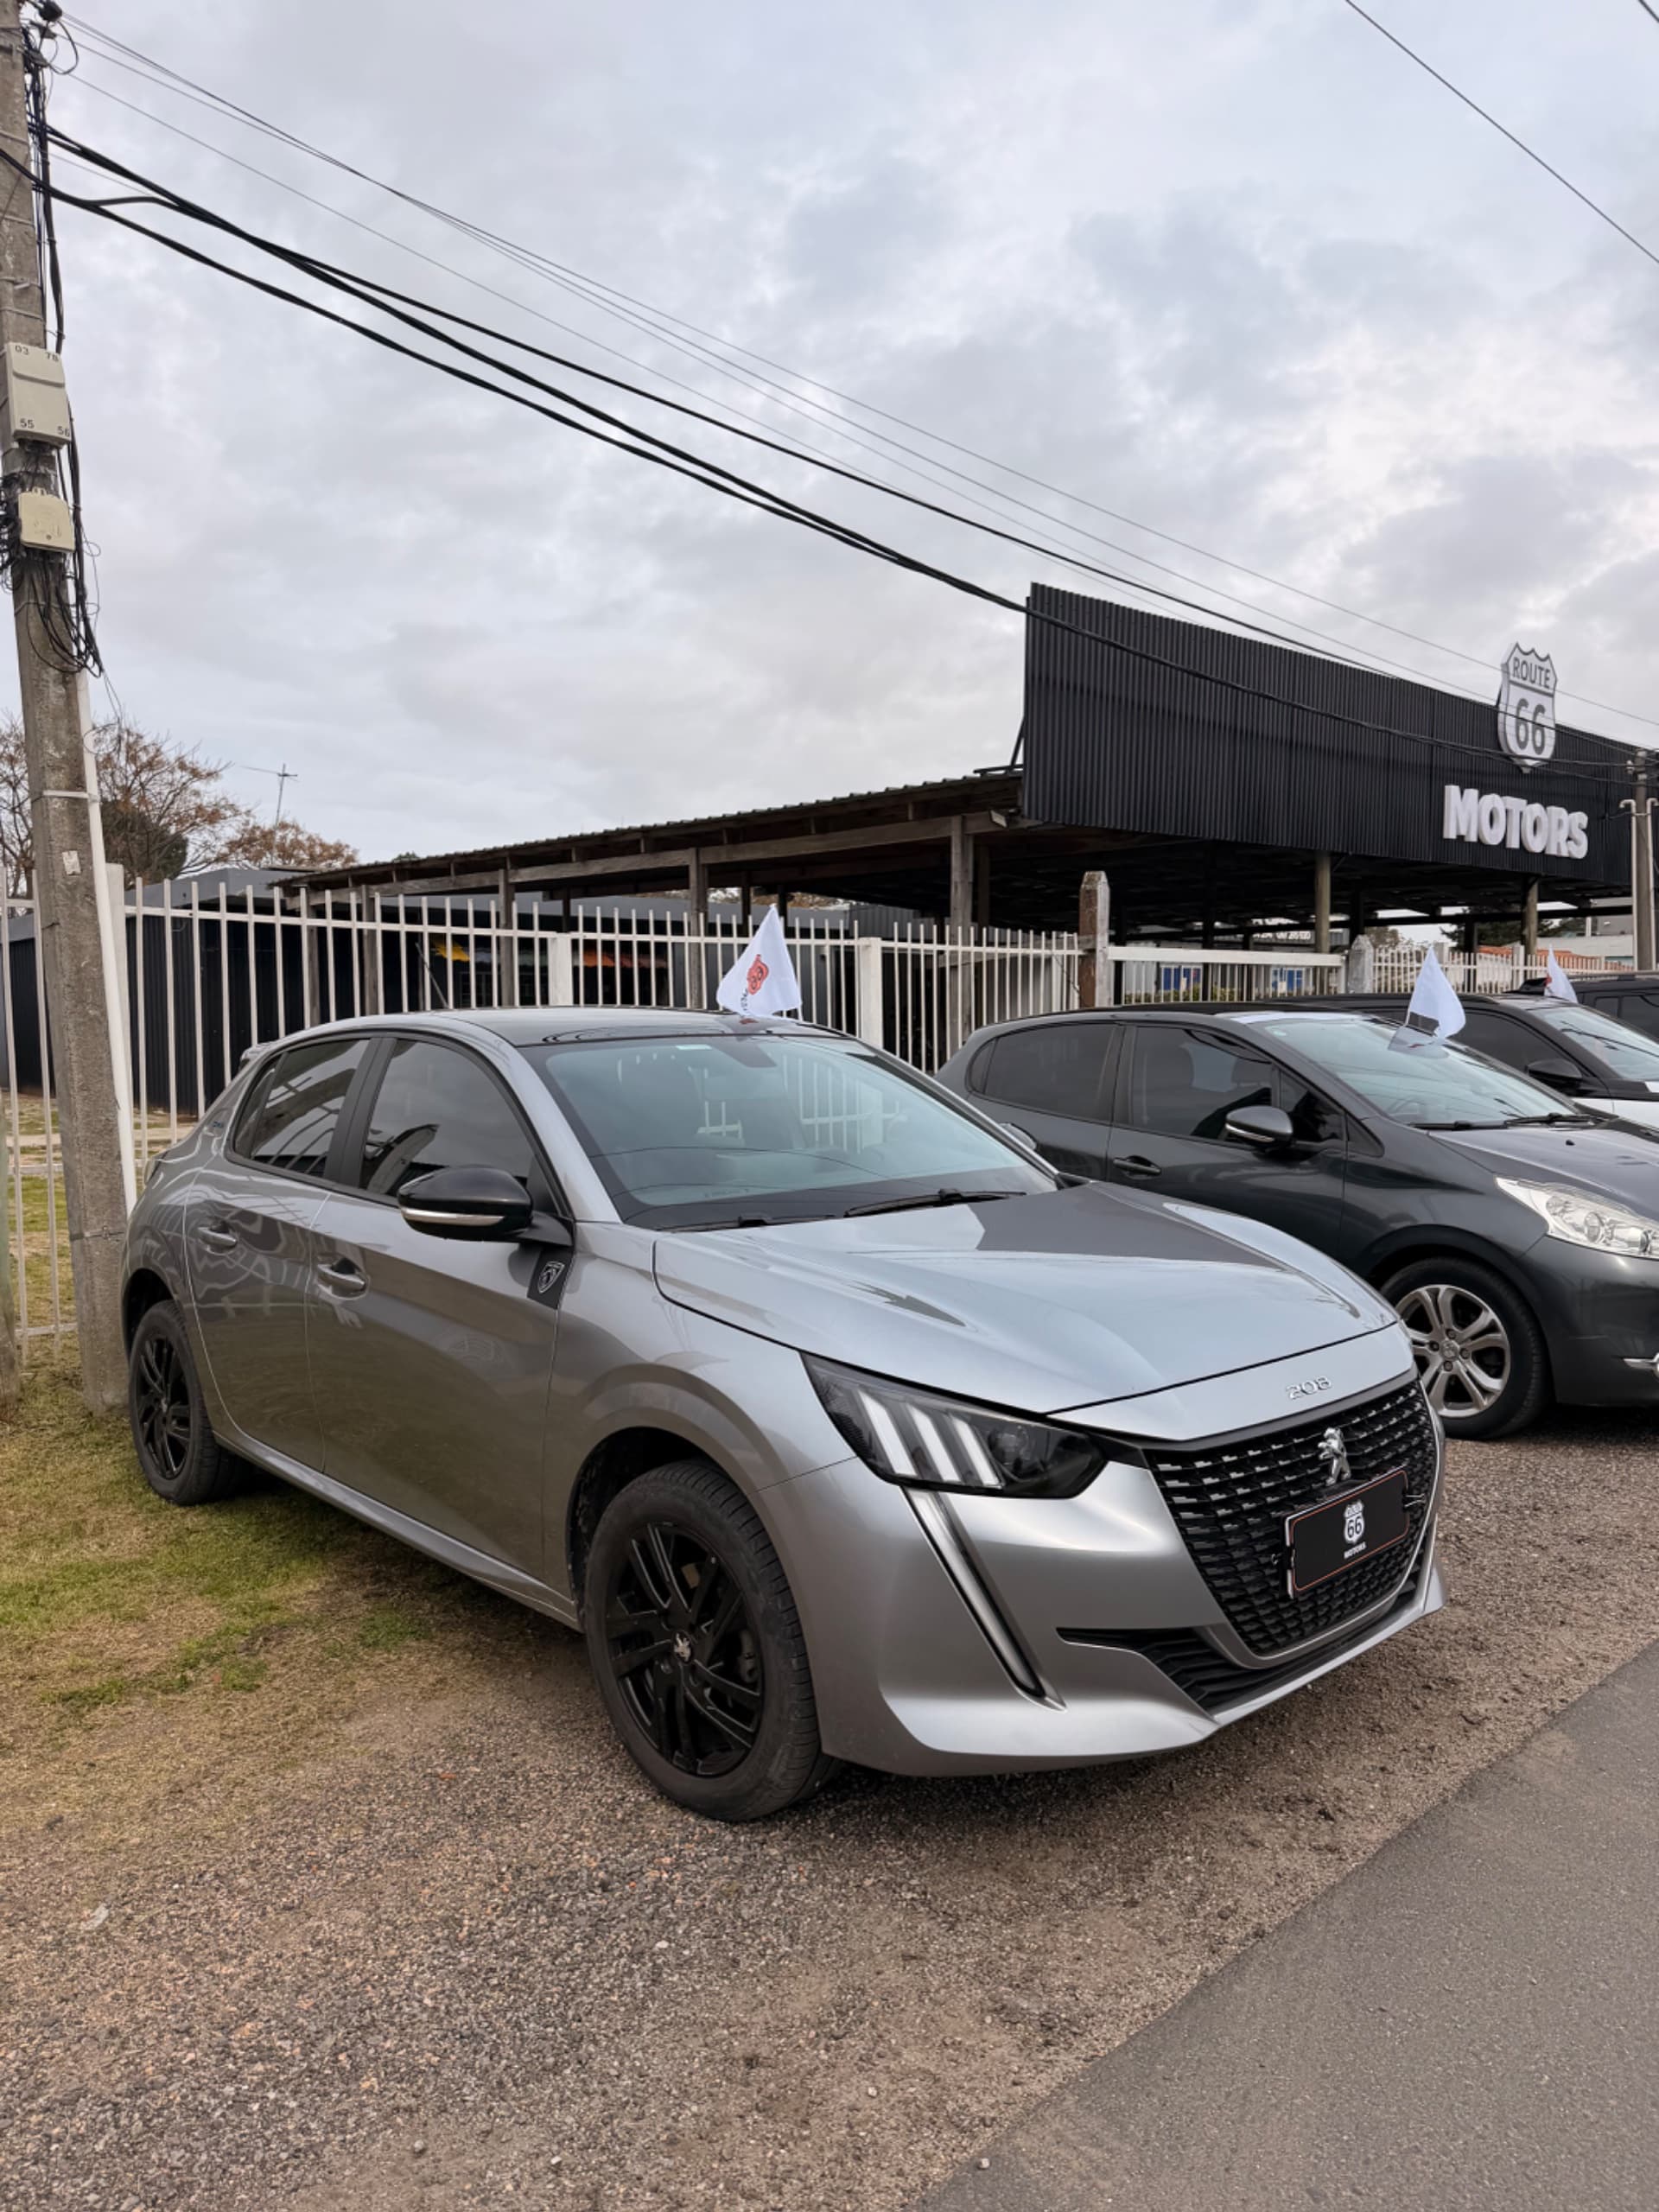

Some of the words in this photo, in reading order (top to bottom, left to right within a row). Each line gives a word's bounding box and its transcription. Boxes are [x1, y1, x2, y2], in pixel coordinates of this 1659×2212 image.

[20, 417, 35, 429] 55
[1512, 657, 1551, 690] ROUTE
[1515, 697, 1546, 756] 66
[1443, 784, 1588, 860] MOTORS
[1286, 1376, 1332, 1400] 208
[1347, 1516, 1363, 1539] 66
